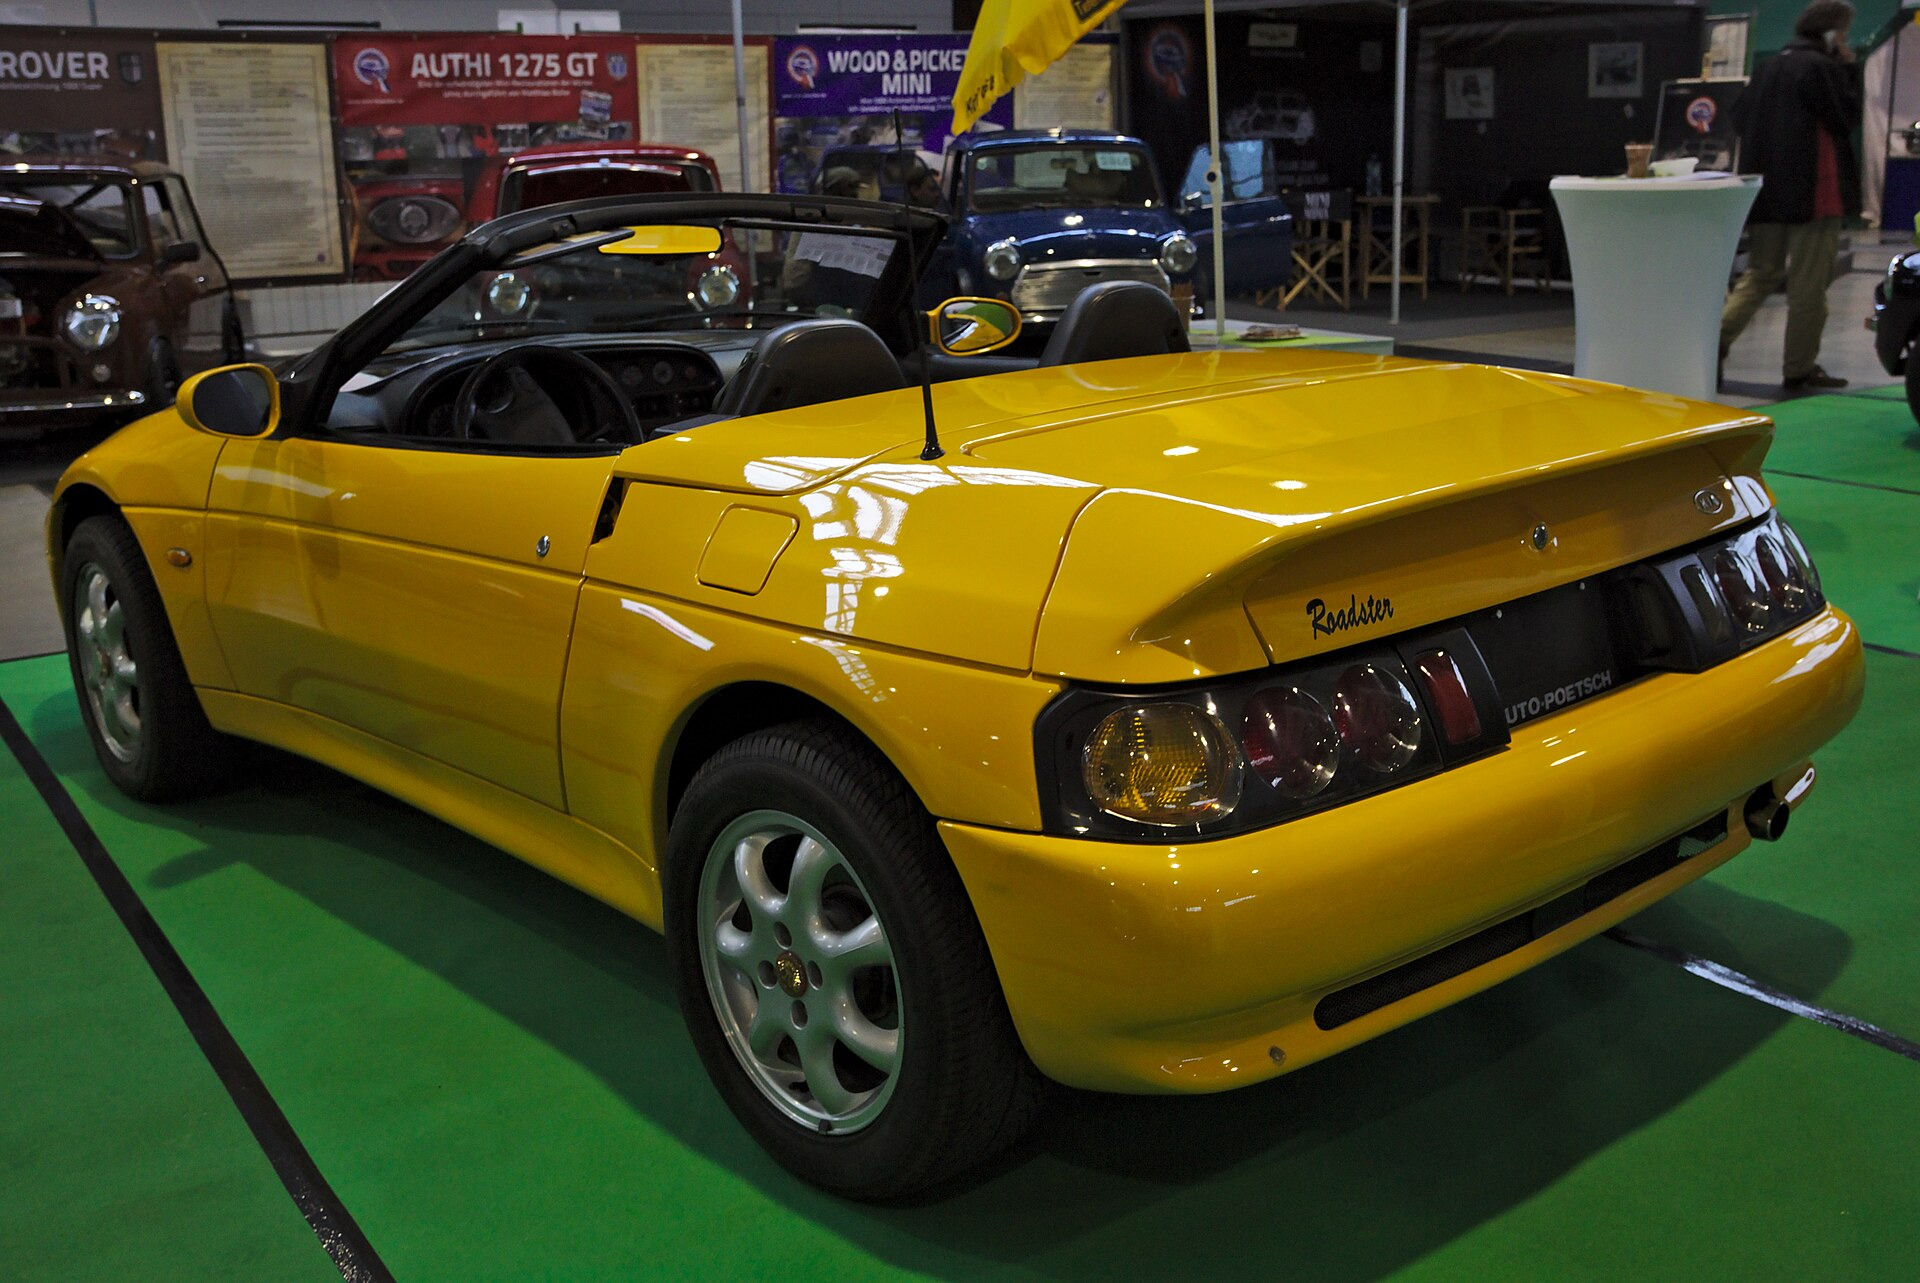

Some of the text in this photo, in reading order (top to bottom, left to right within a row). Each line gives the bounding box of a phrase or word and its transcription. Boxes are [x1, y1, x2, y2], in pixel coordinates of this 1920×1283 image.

[0, 50, 110, 79] ROVER
[410, 52, 598, 78] AUTHI 1275 GT
[827, 49, 890, 74] WOOD
[881, 73, 932, 95] MINI
[1306, 593, 1394, 640] Roadster
